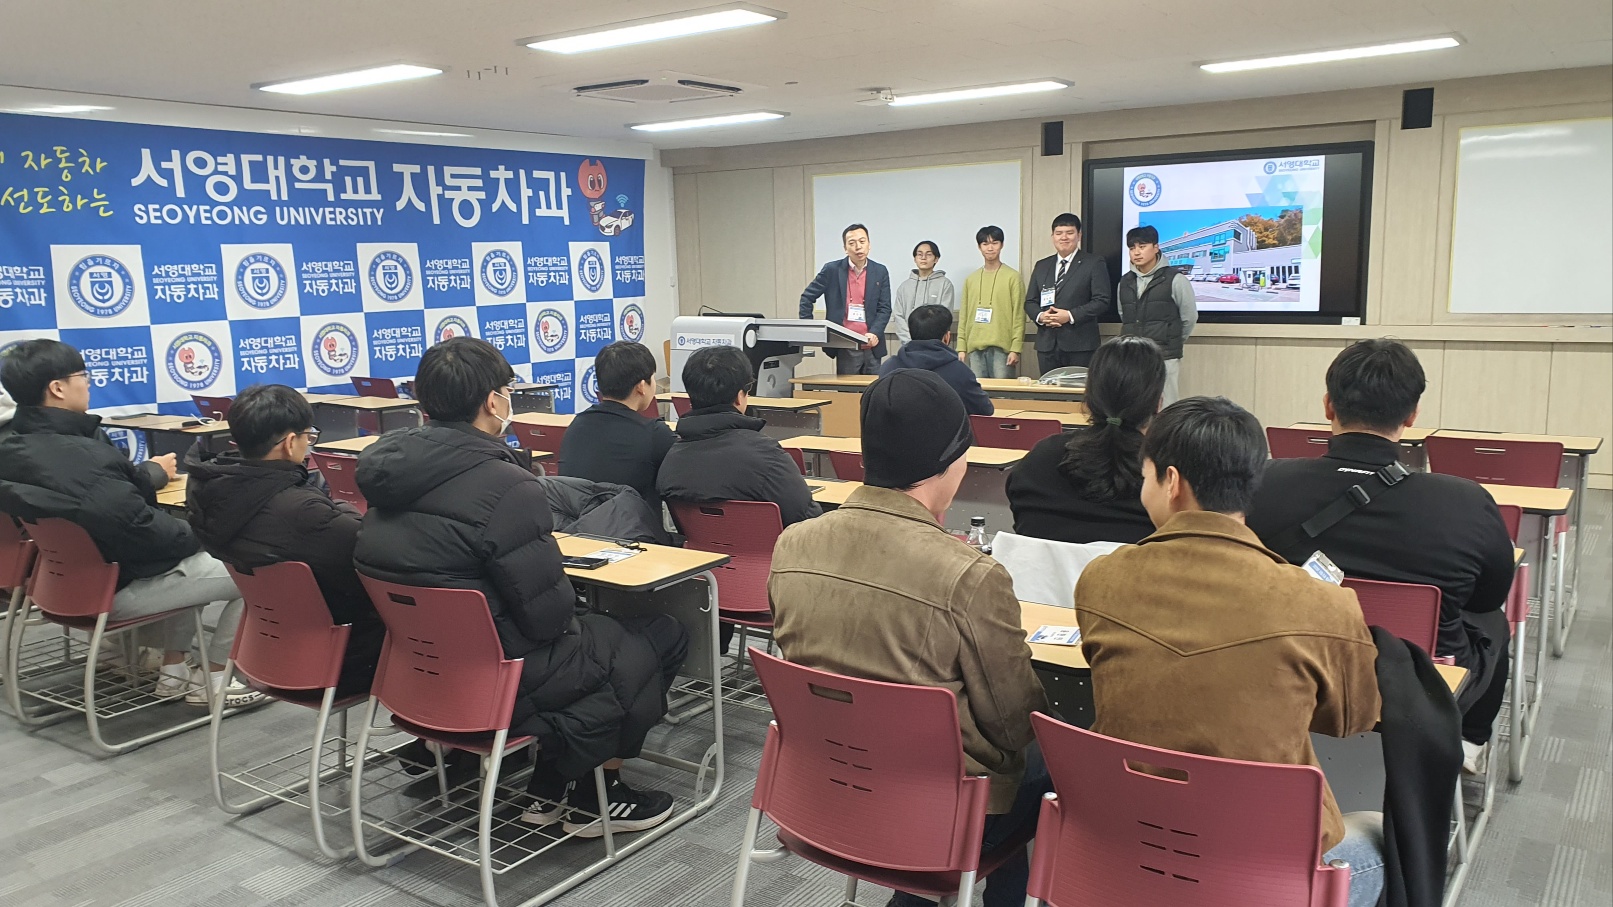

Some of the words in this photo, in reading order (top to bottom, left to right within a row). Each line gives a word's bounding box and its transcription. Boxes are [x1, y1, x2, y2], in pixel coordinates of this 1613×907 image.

[21, 147, 108, 181] 자동차
[131, 148, 382, 203] 서영대학교
[392, 164, 572, 228] 자동차과
[0, 186, 114, 217] 선도하는
[134, 204, 268, 225] SEOYEONG
[275, 206, 384, 226] UNIVERSITY
[301, 260, 355, 273] 서영대학교
[425, 259, 470, 270] 서영대학교
[527, 256, 568, 267] 서영대학교
[614, 255, 645, 265] 서영대학교
[0, 265, 45, 279] 대학교
[151, 263, 217, 278] 서영대학교
[615, 270, 645, 283] 자동차과
[427, 276, 471, 291] 자동차과
[528, 271, 569, 287] 자동차과
[154, 283, 219, 303] 자동차과
[303, 279, 356, 296] 자동차과
[0, 287, 47, 308] 동차과
[485, 318, 525, 330] 서영대학교
[579, 313, 611, 324] 서영대학교
[372, 326, 422, 339] 서영대학교
[579, 327, 612, 342] 자동차과
[239, 335, 296, 349] 서영대학교
[374, 343, 423, 361] 자동차과
[241, 354, 299, 373] 자동차과
[88, 367, 149, 387] 동차과
[536, 372, 572, 384] 서영대학교
